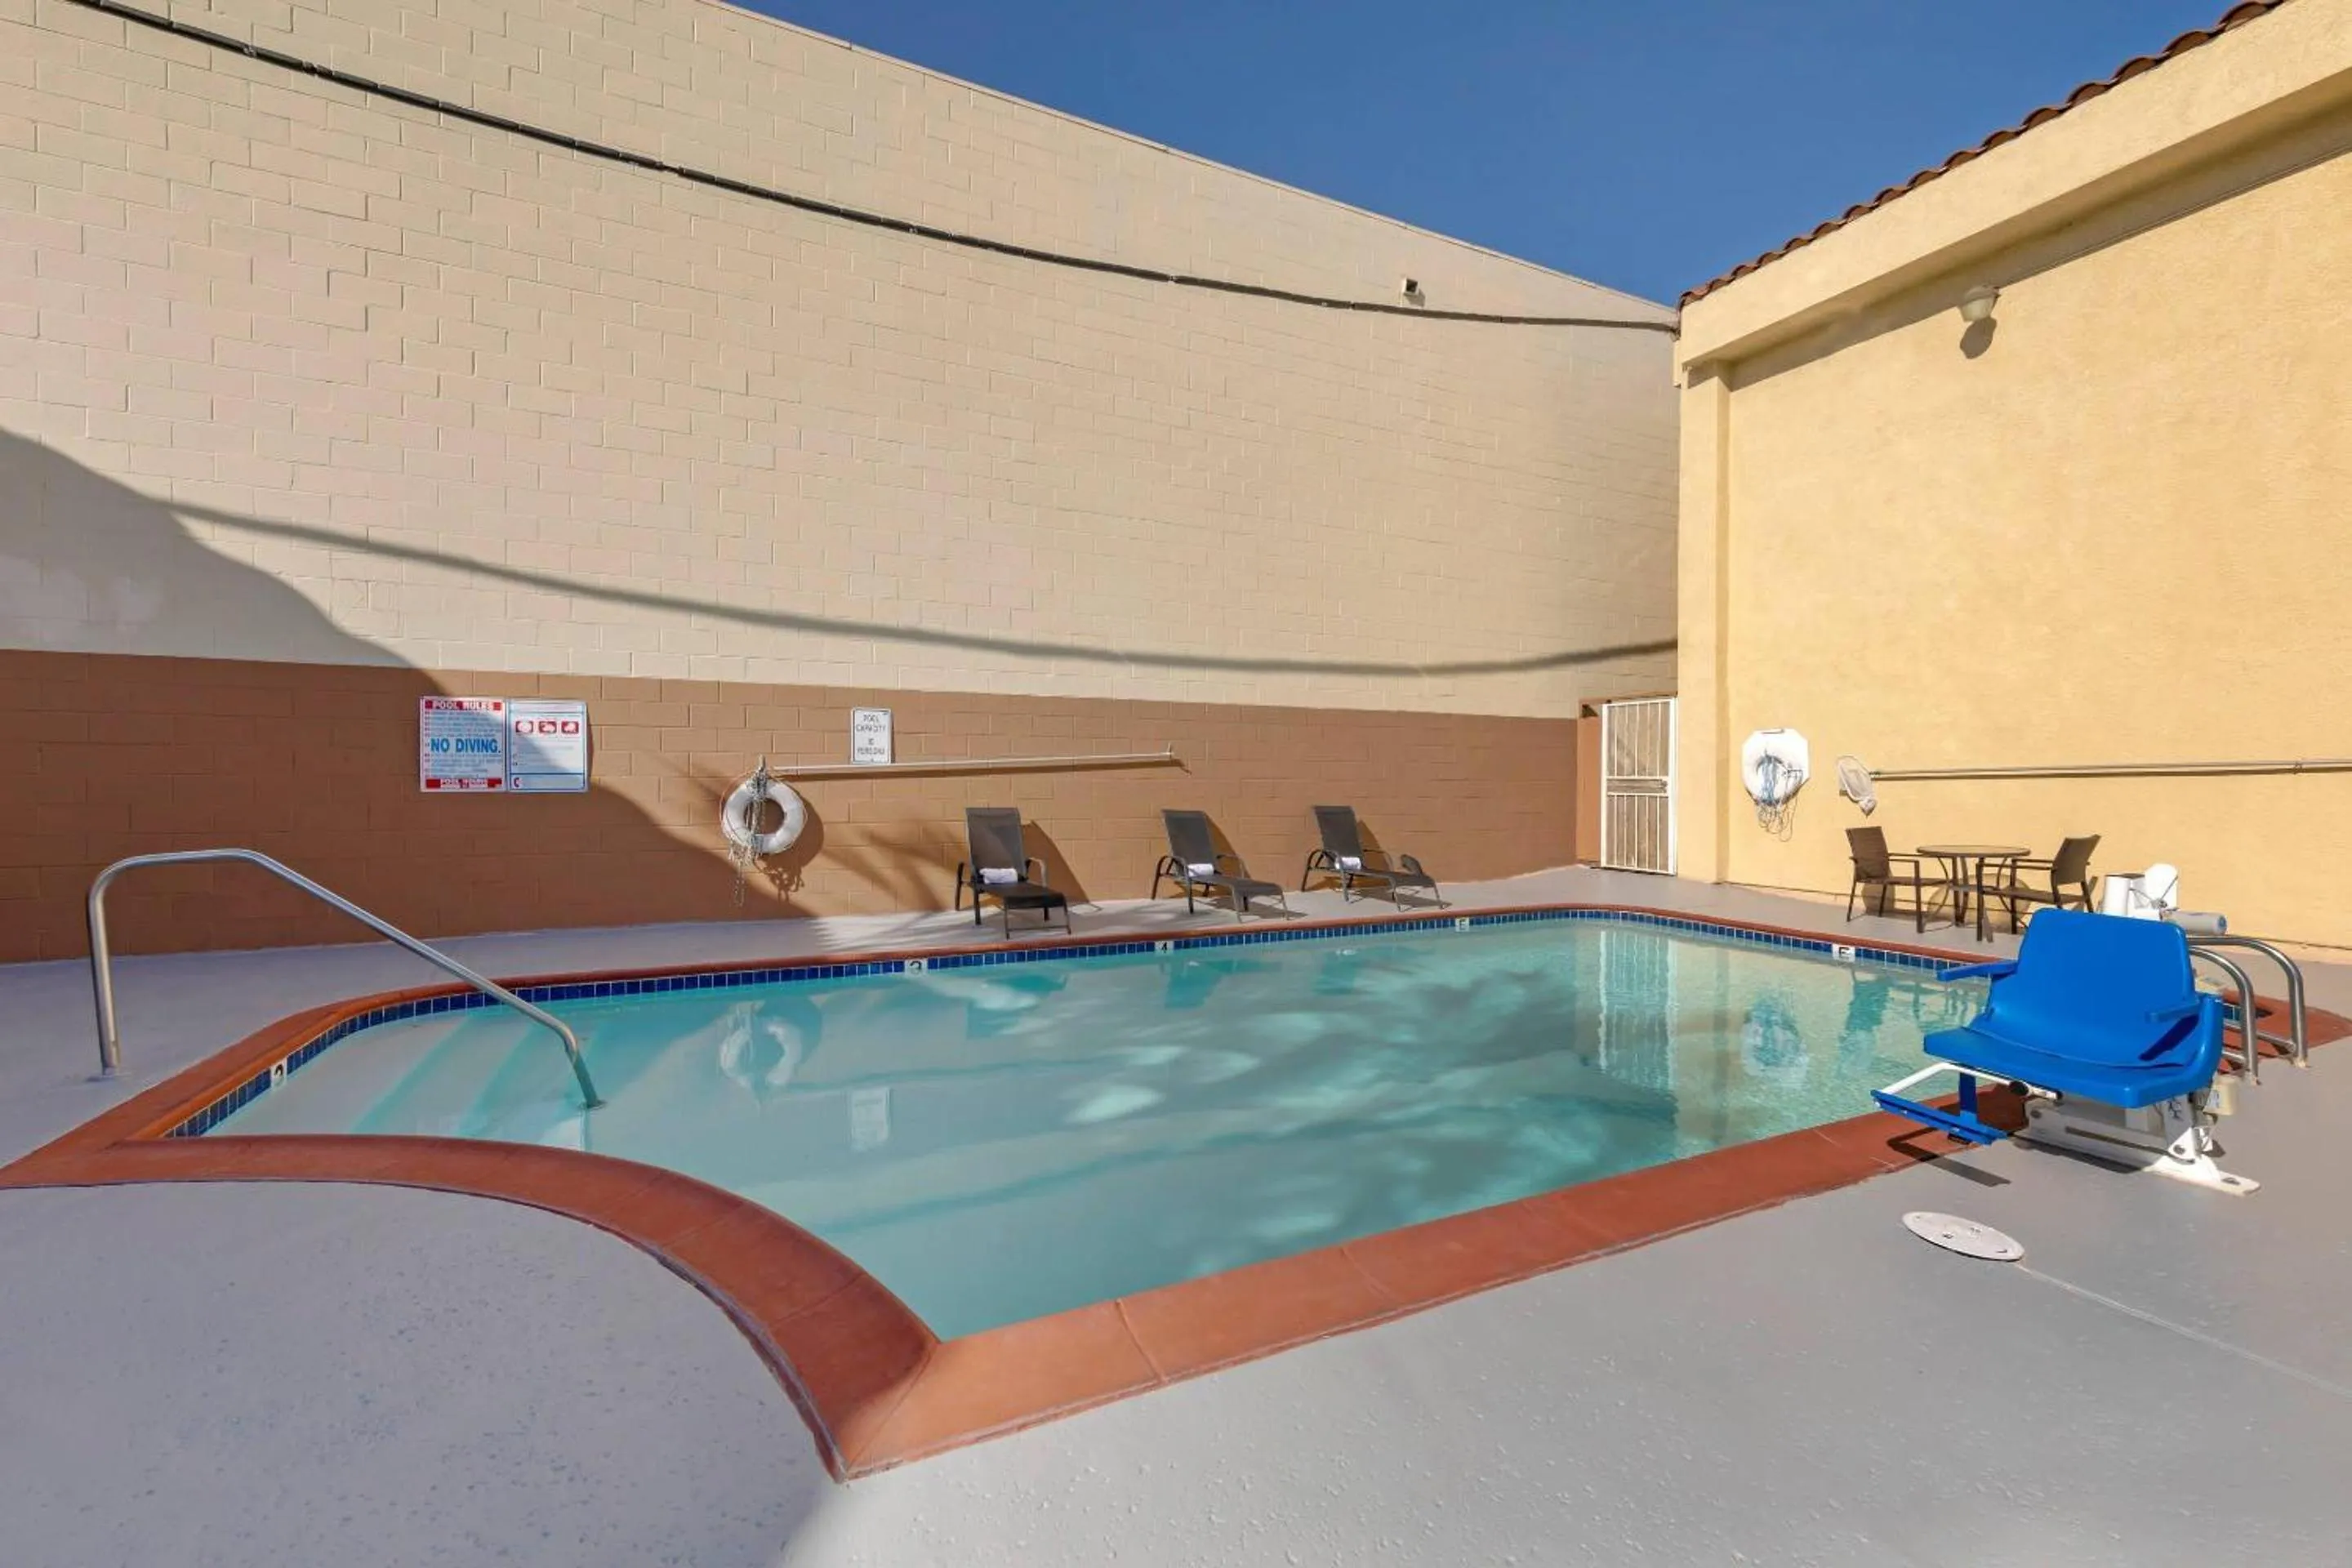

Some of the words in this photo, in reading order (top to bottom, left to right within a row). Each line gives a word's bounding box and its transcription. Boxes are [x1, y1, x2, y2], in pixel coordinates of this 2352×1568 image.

[433, 700, 458, 710] POOL
[462, 701, 492, 711] RULES
[430, 737, 450, 752] NO
[456, 737, 501, 754] DIVING.
